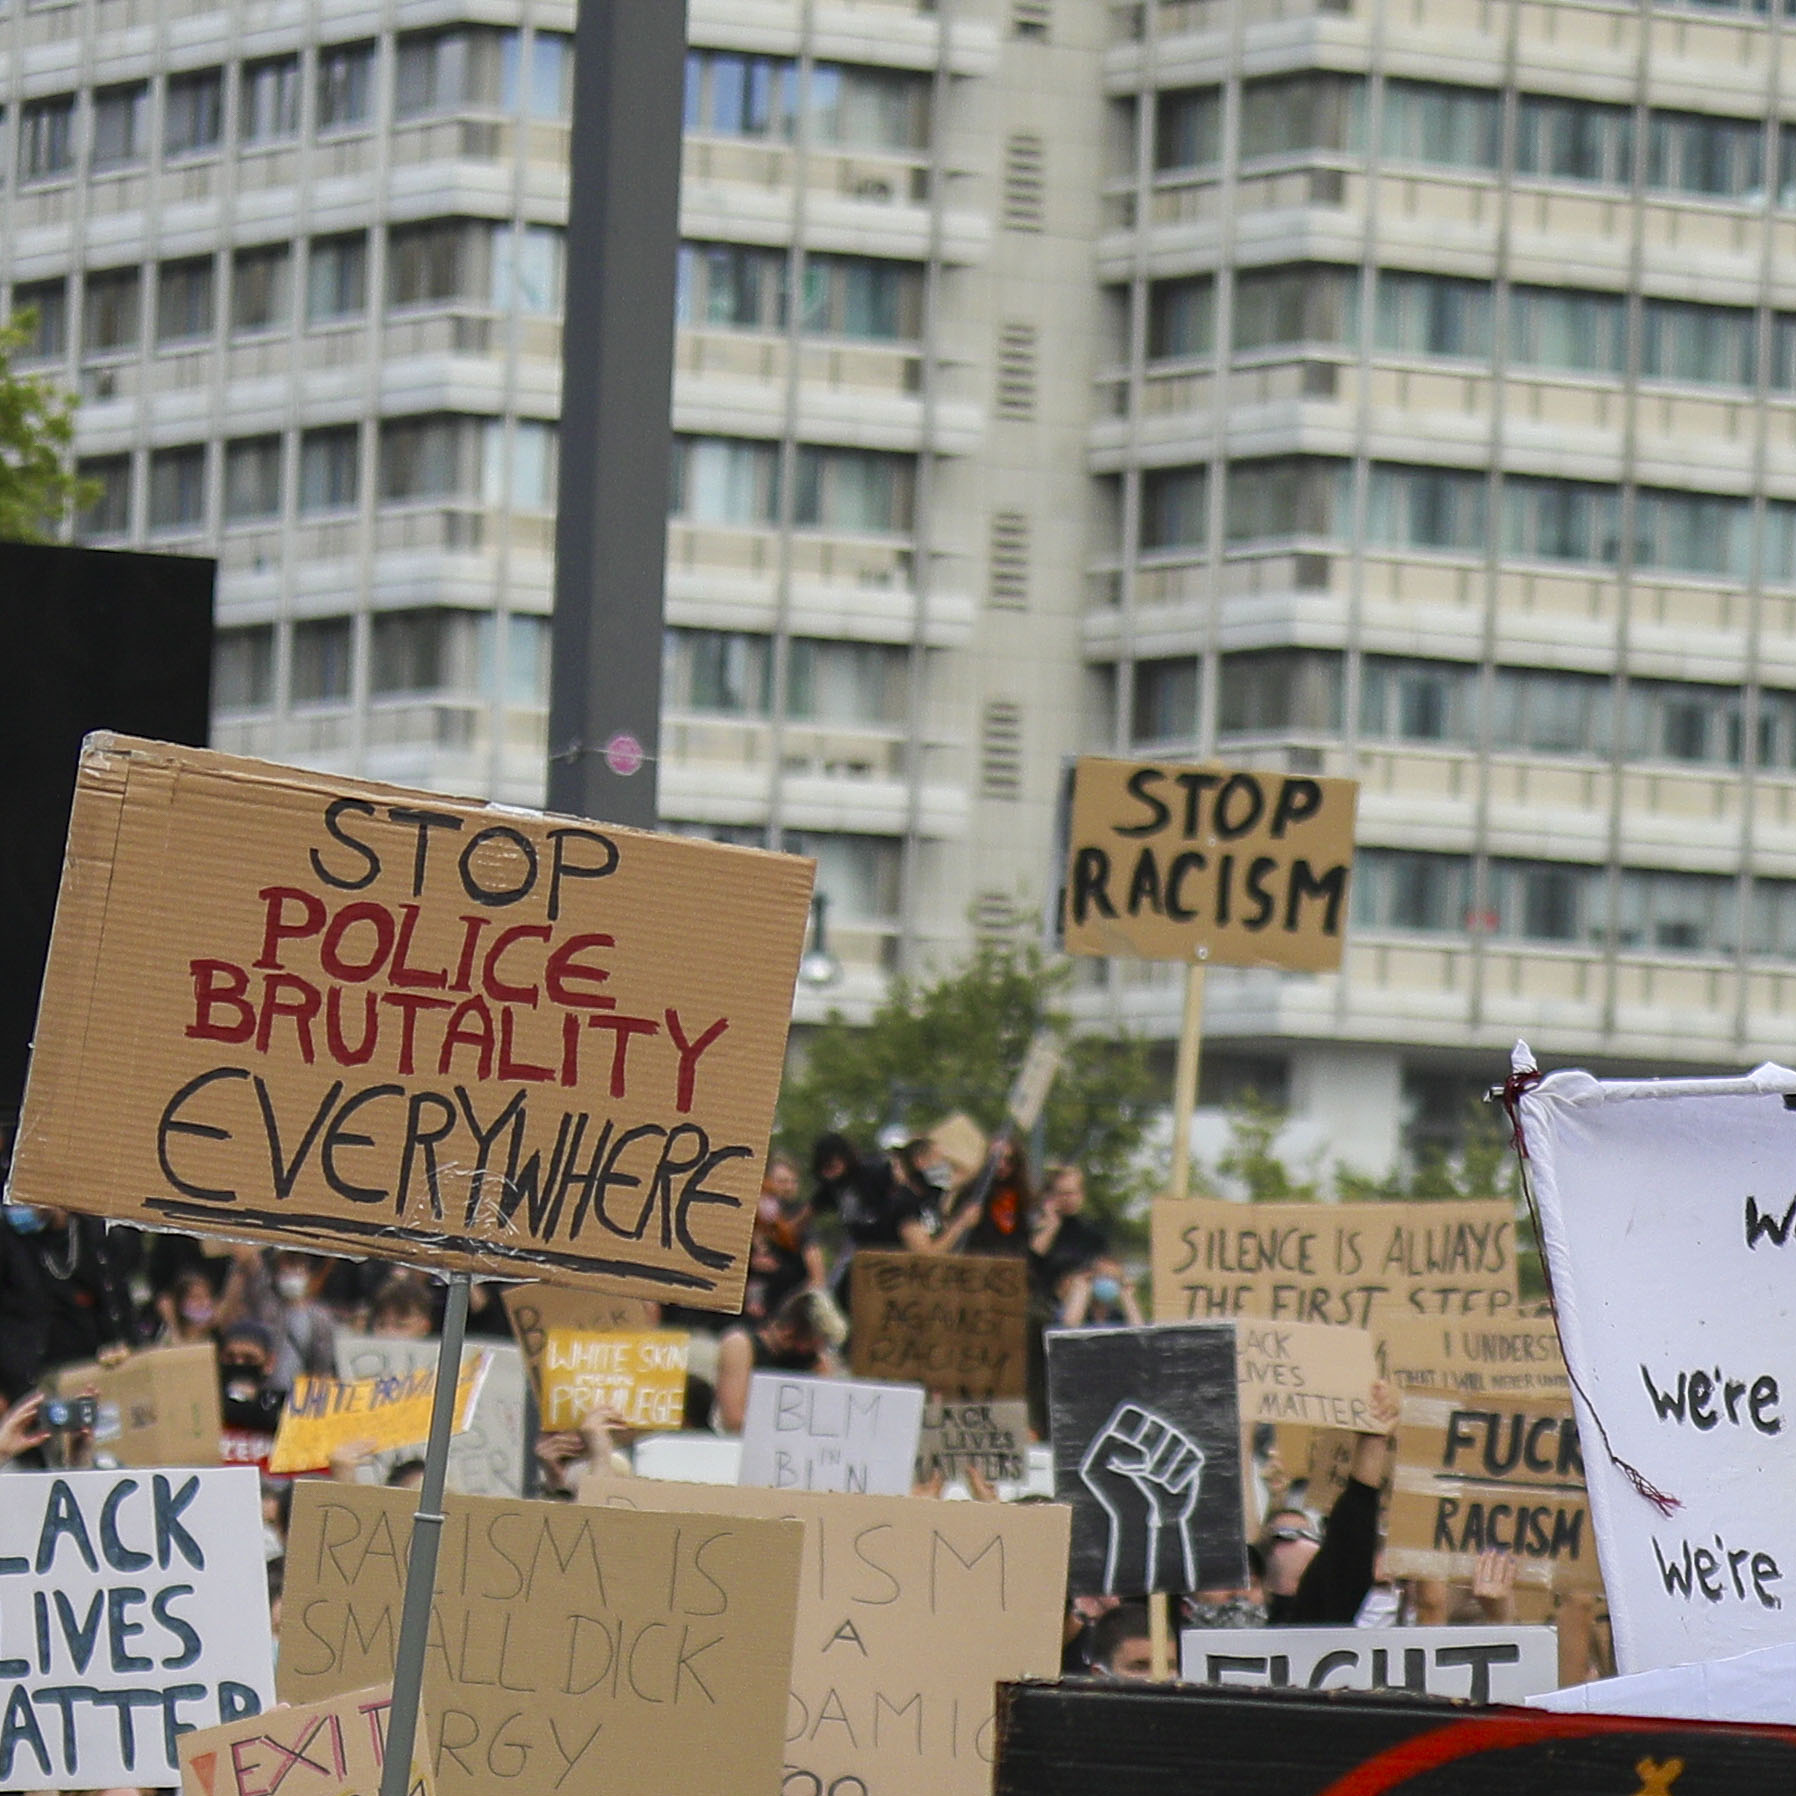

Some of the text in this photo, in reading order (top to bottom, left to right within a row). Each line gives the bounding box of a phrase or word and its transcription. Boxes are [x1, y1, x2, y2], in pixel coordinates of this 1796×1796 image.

[1112, 767, 1324, 841] STOP
[309, 797, 620, 920] STOP
[1070, 847, 1349, 937] RACISM
[253, 886, 615, 1011] POLICE
[184, 958, 729, 1114] BRUTALITY
[156, 1066, 754, 1271] EVERYWHERE
[1172, 1222, 1511, 1277] SILENCE IS ALWAYS
[1238, 1328, 1292, 1360] ACK
[1271, 1284, 1389, 1330] FIRST
[548, 1340, 688, 1373] WHITE SKIN
[774, 1384, 882, 1440] BLM
[1639, 1361, 1784, 1436] we're
[1443, 1409, 1585, 1480] FUCK
[316, 1501, 734, 1616] RAISM IS
[1432, 1495, 1588, 1561] RACISM
[1651, 1530, 1783, 1611] we're
[565, 1613, 725, 1706] DICK
[821, 1619, 869, 1657] A
